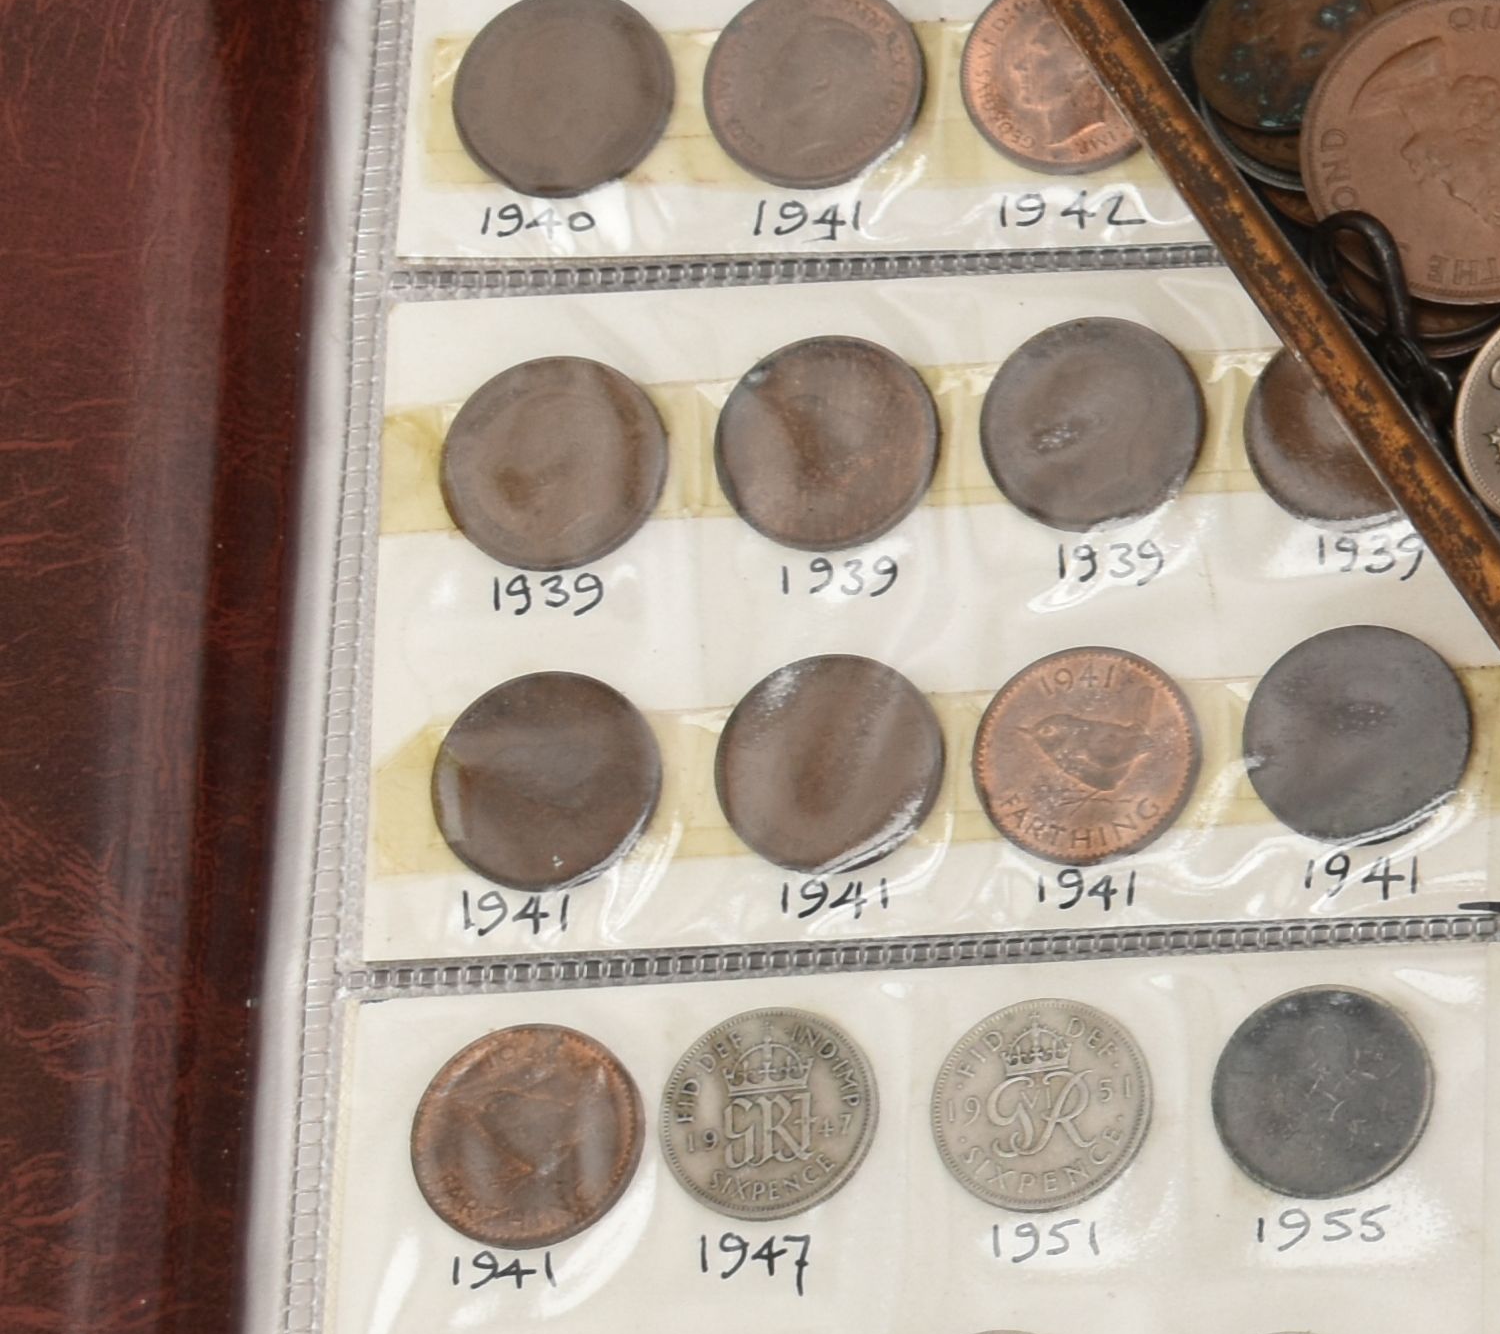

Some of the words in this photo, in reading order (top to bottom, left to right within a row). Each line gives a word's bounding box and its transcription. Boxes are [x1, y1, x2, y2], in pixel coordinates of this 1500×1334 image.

[481, 204, 595, 237] 1940
[754, 201, 861, 240] 1941
[1000, 191, 1146, 229] 1942
[783, 558, 898, 597] 1939
[1059, 544, 1163, 582] 1939
[1319, 532, 1424, 581] 1939
[494, 573, 603, 616] 1939
[1000, 794, 1166, 862] FARTHING
[1039, 869, 1135, 911] 1941
[1305, 852, 1417, 900] 1941
[463, 891, 569, 936] 1941
[781, 878, 888, 919] 1941
[993, 1220, 1095, 1263] 1951
[1257, 1206, 1386, 1251] 1955
[453, 1251, 553, 1289] 1941
[701, 1233, 810, 1296] 1947
